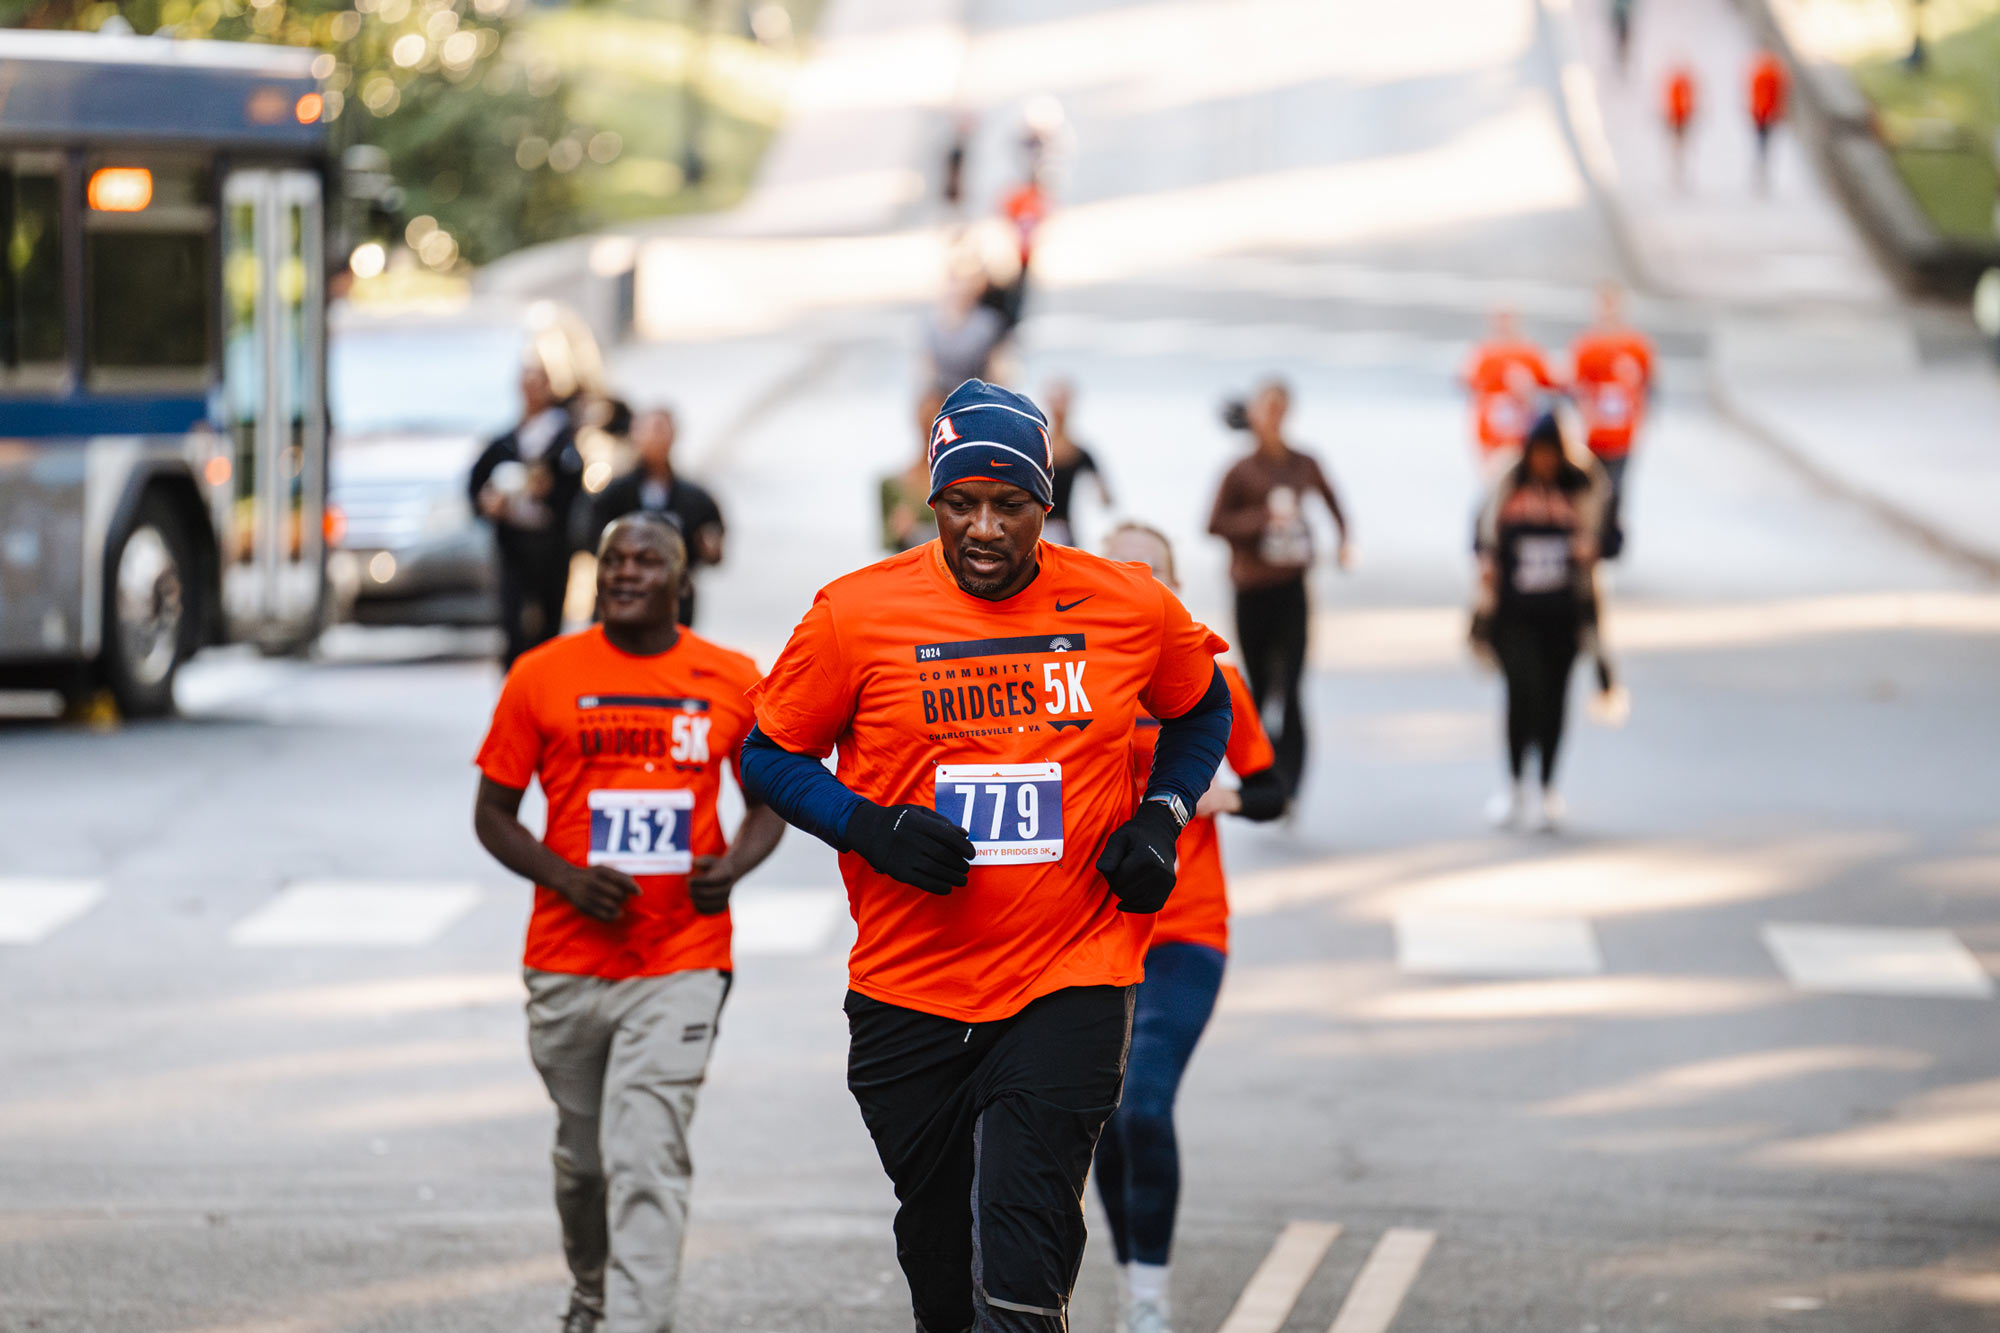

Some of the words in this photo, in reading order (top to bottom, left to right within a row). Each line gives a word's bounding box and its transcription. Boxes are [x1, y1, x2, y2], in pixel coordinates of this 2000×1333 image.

[920, 647, 941, 659] 2024
[919, 663, 1032, 682] COMMUNITY
[922, 680, 1037, 724] BRIDGES
[1043, 660, 1093, 715] 5K
[670, 714, 712, 763] 5K
[928, 726, 1013, 741] CHARLOTTESVILLE
[1028, 724, 1040, 733] VA
[955, 783, 1039, 840] 779
[603, 808, 676, 852] 752
[1000, 847, 1039, 856] BRIDGES
[1039, 847, 1051, 855] 5K
